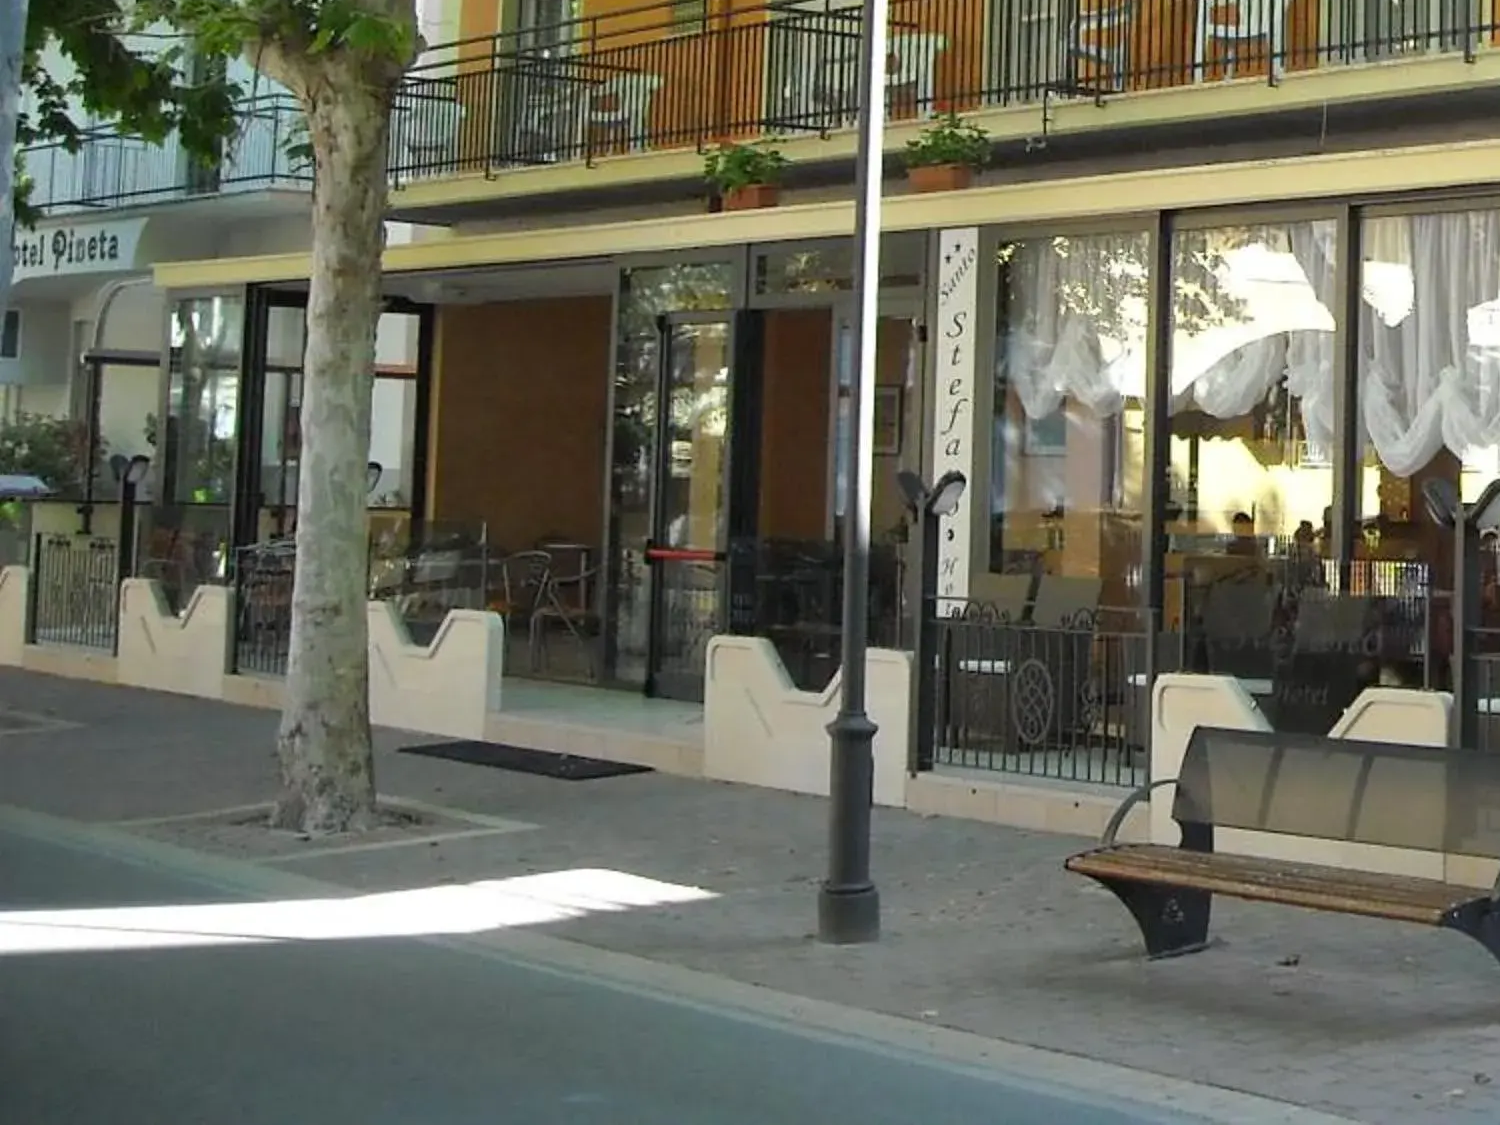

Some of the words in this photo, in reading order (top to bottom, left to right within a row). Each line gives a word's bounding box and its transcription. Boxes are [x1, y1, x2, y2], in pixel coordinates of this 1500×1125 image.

[52, 228, 119, 270] Pineta
[940, 247, 976, 306] Santo
[941, 312, 968, 516] Stefa
